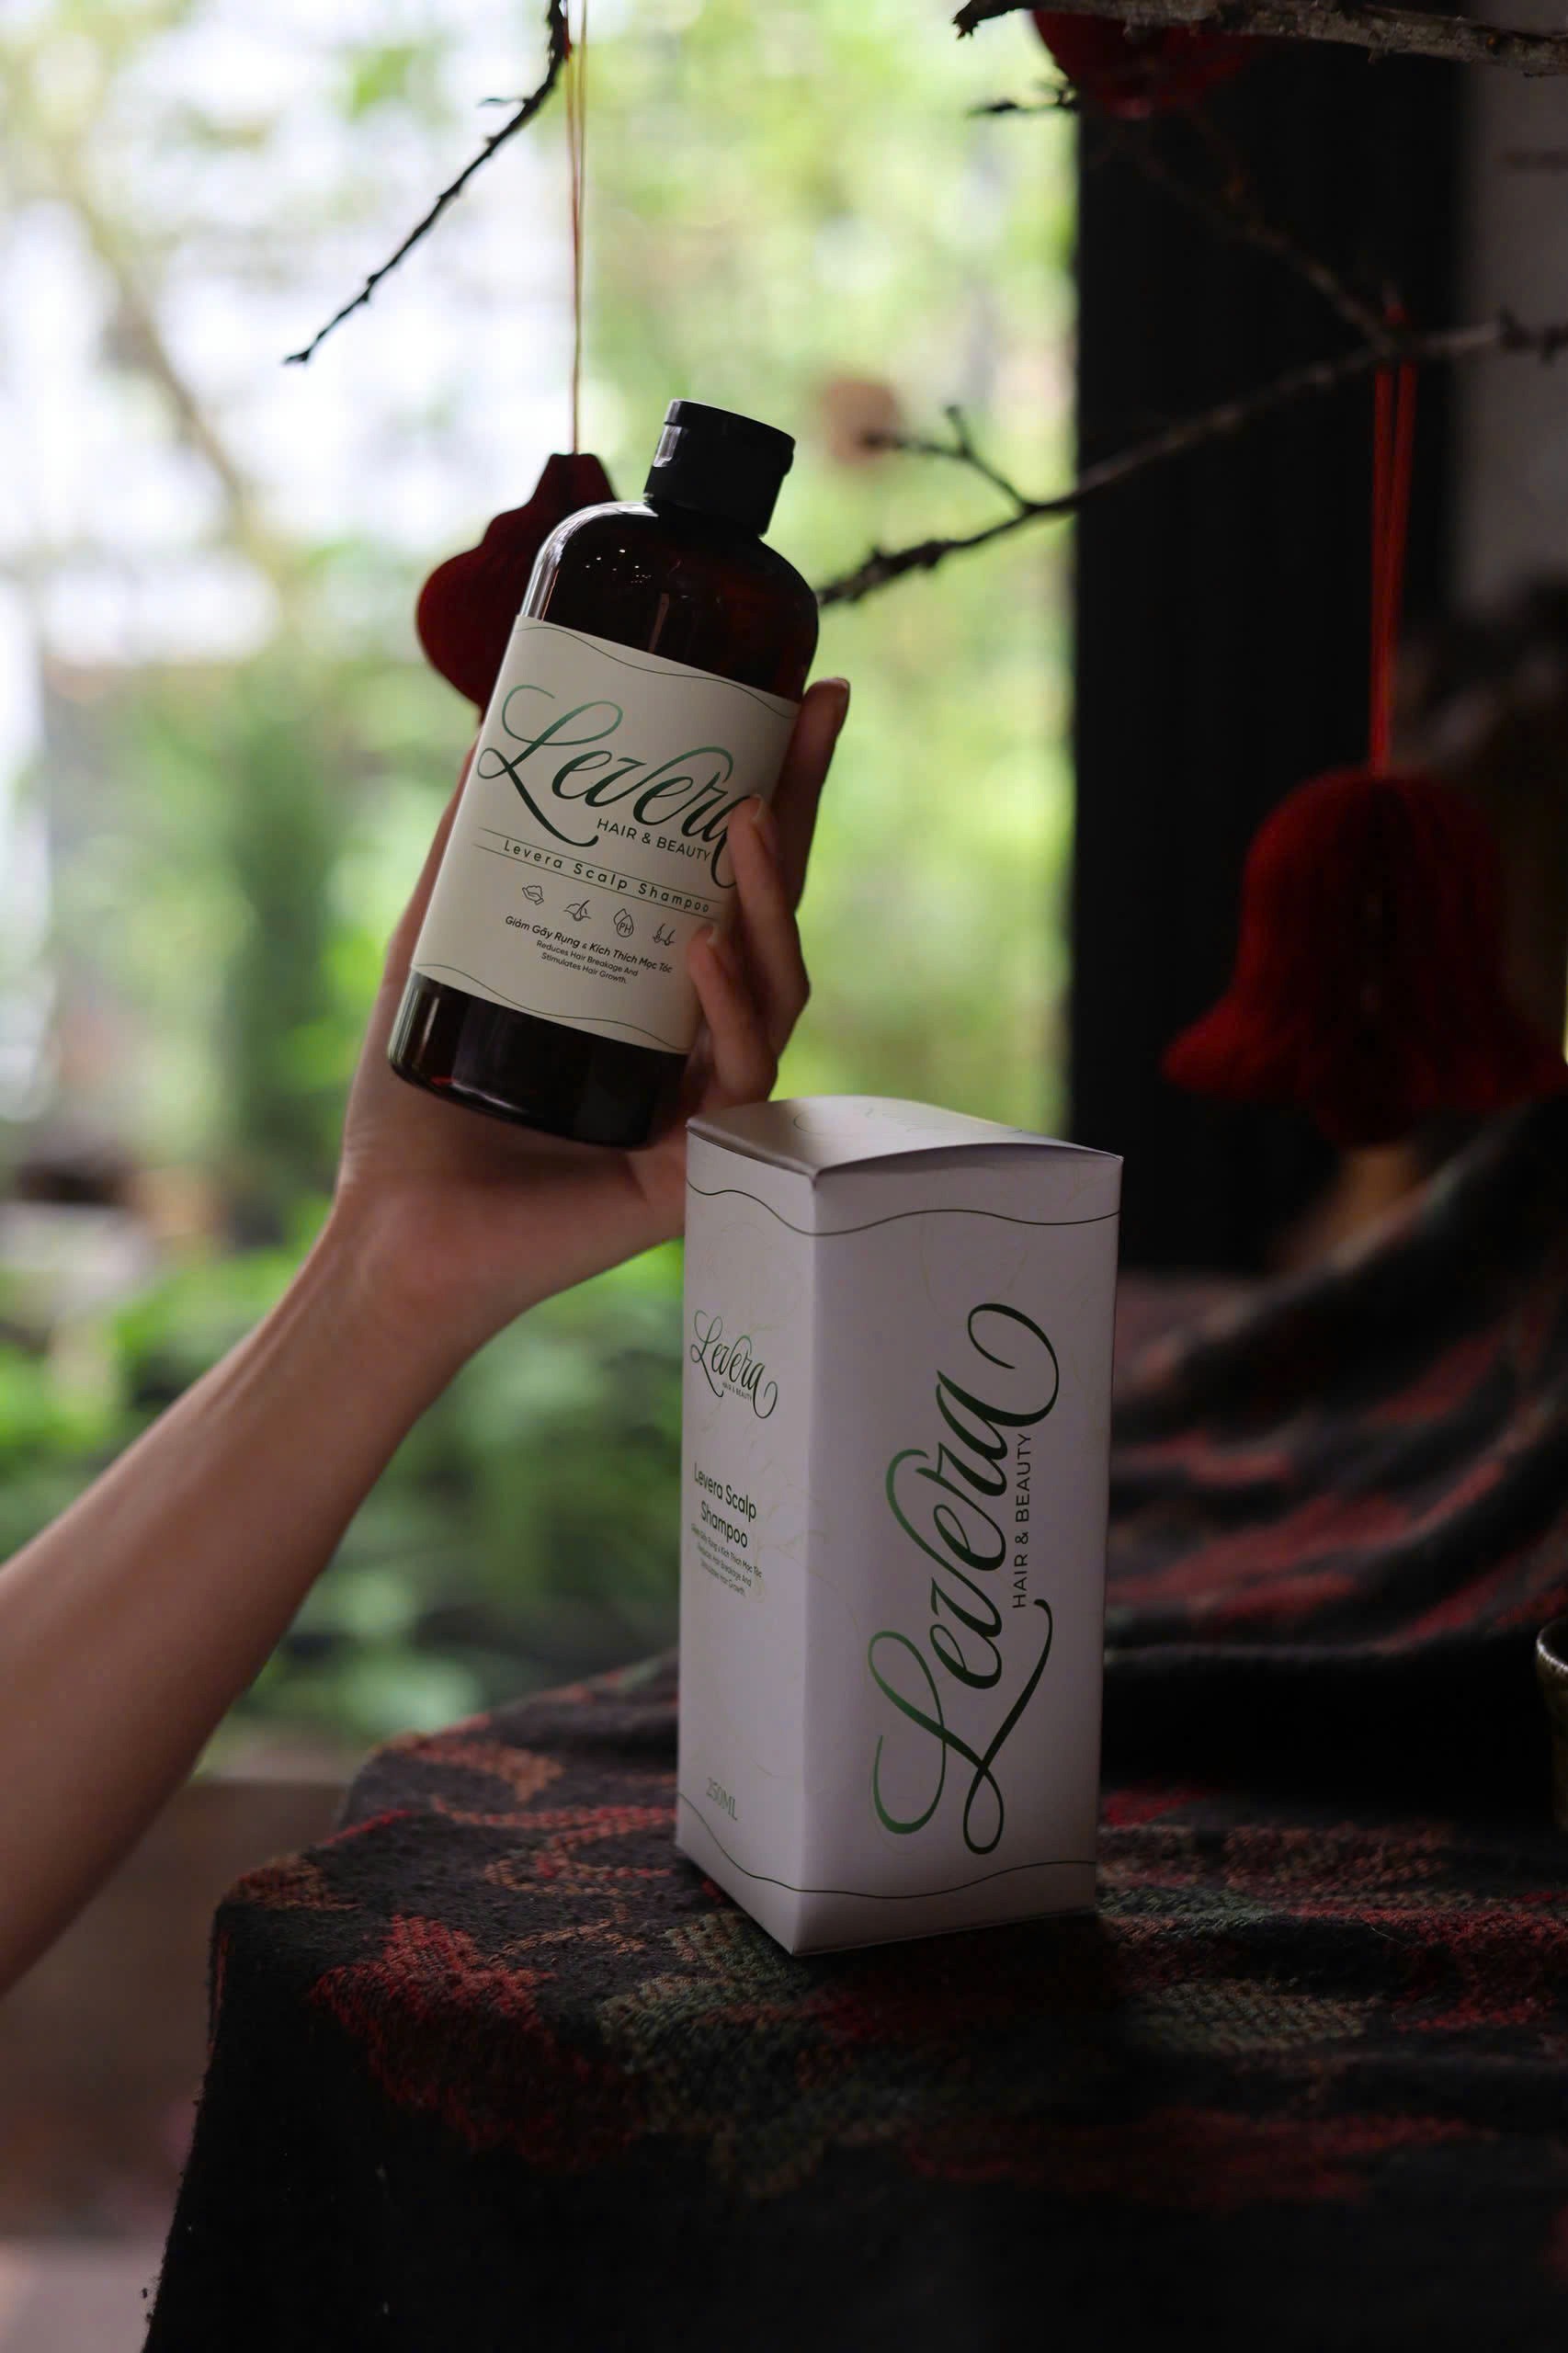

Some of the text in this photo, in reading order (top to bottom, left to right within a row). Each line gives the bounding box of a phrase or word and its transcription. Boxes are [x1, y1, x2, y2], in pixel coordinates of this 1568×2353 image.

[597, 818, 712, 862] HAIR & BEAUTY
[504, 839, 710, 914] Levera Scalp Shampoo
[554, 931, 581, 949] Rụng
[588, 942, 611, 957] Kích
[613, 949, 638, 965] Thích
[619, 922, 631, 935] PH
[536, 939, 639, 977] Reduces Hair Breakage And
[540, 952, 581, 971] Stimulates
[582, 964, 598, 976] Hair
[690, 1310, 778, 1419] Levera
[694, 1461, 757, 1523] Levera Scalp
[700, 1500, 748, 1549] Shampoo
[1012, 1433, 1032, 1608] HAIR & BEAUTY
[868, 1302, 1060, 1855] Levera
